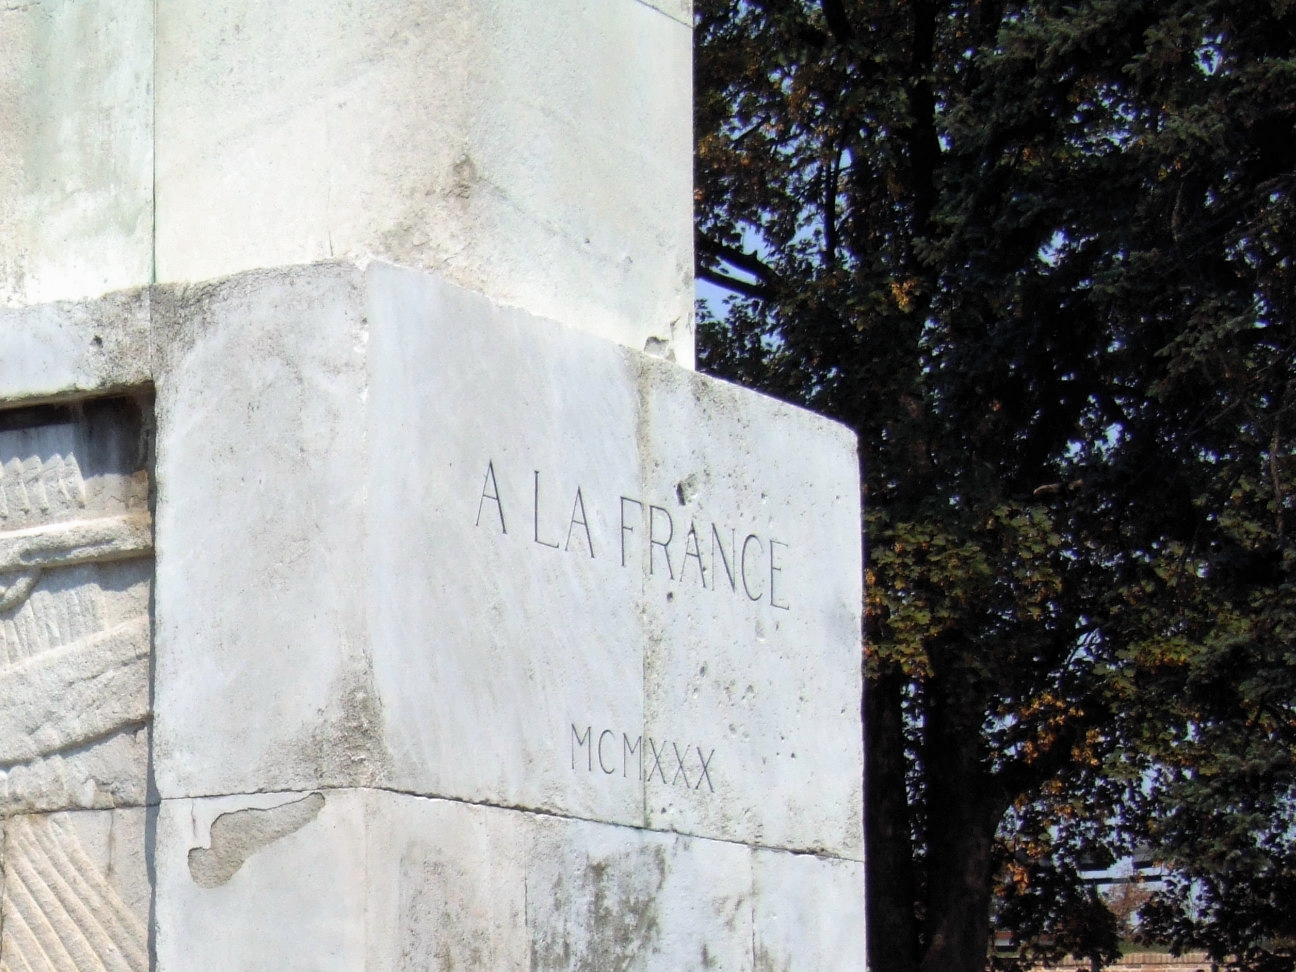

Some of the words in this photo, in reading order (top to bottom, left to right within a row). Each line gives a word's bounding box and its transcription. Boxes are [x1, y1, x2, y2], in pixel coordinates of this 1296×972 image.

[475, 459, 507, 535] A
[533, 470, 595, 559] LA
[619, 495, 790, 611] FRANCE
[570, 722, 716, 793] MCMXXX
